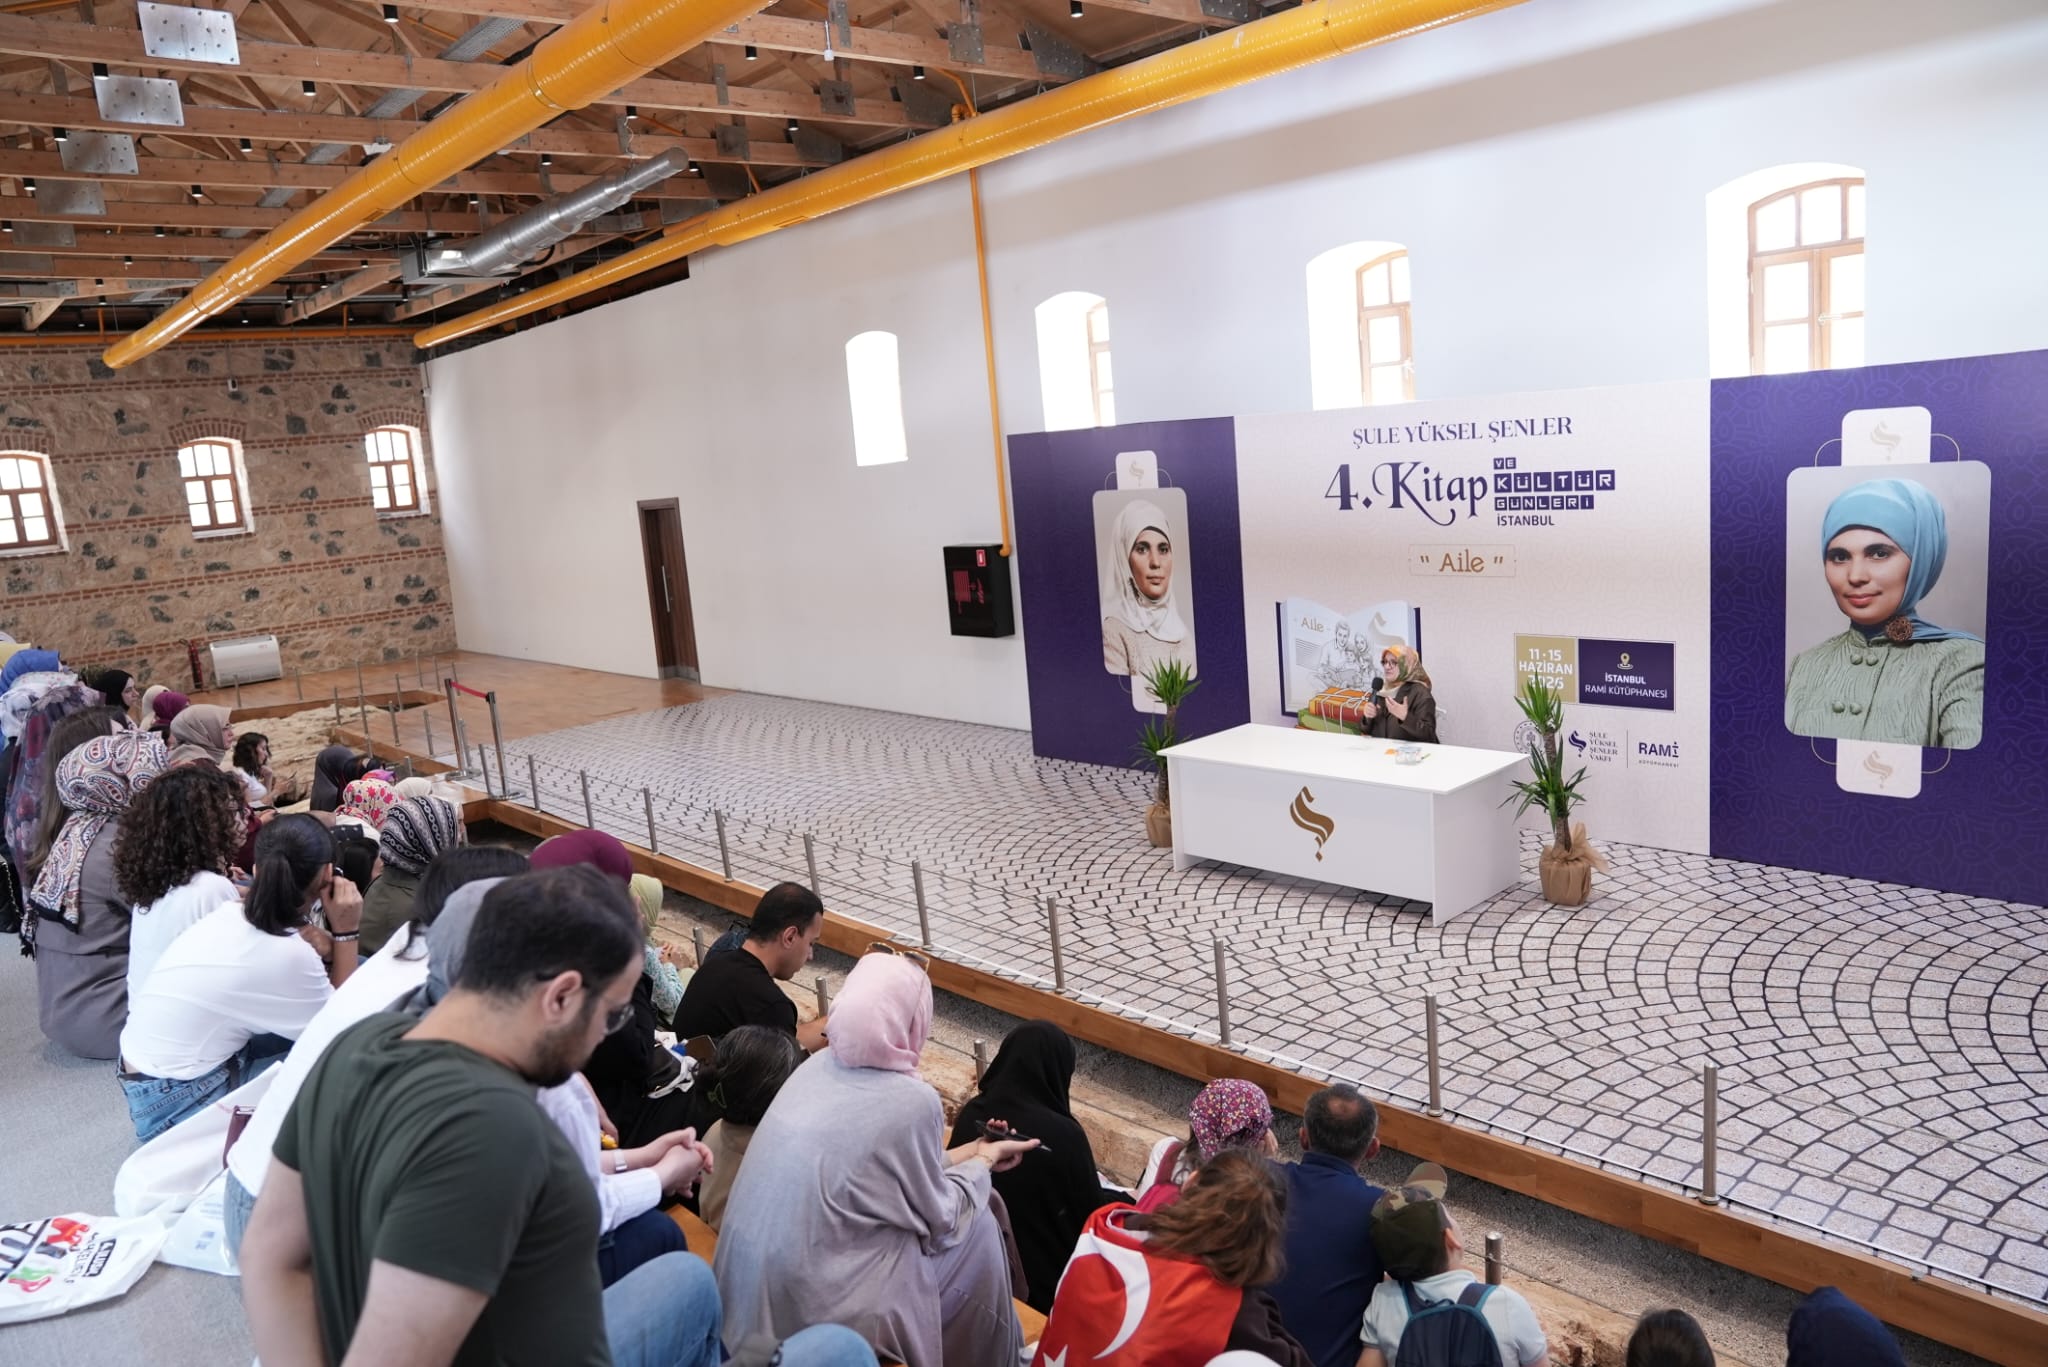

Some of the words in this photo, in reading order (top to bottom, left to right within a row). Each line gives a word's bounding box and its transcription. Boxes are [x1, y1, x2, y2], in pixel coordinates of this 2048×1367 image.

[1353, 427, 1400, 449] ŞULE
[1405, 421, 1482, 443] YÜKSEL
[1488, 416, 1573, 443] ŞENLER
[1495, 458, 1516, 469] VE
[1495, 471, 1614, 492] KÜLTÜR
[1324, 464, 1372, 510] 4.
[1372, 461, 1488, 526] Kitap
[1497, 513, 1555, 526] İSTANBUL
[1439, 548, 1485, 573] Aile
[1519, 660, 1573, 675] HAZİRAN
[1605, 672, 1646, 684] İSTANBUL
[1585, 685, 1606, 694] RAMİ
[1608, 686, 1668, 698] KÜTÜPHANESİ
